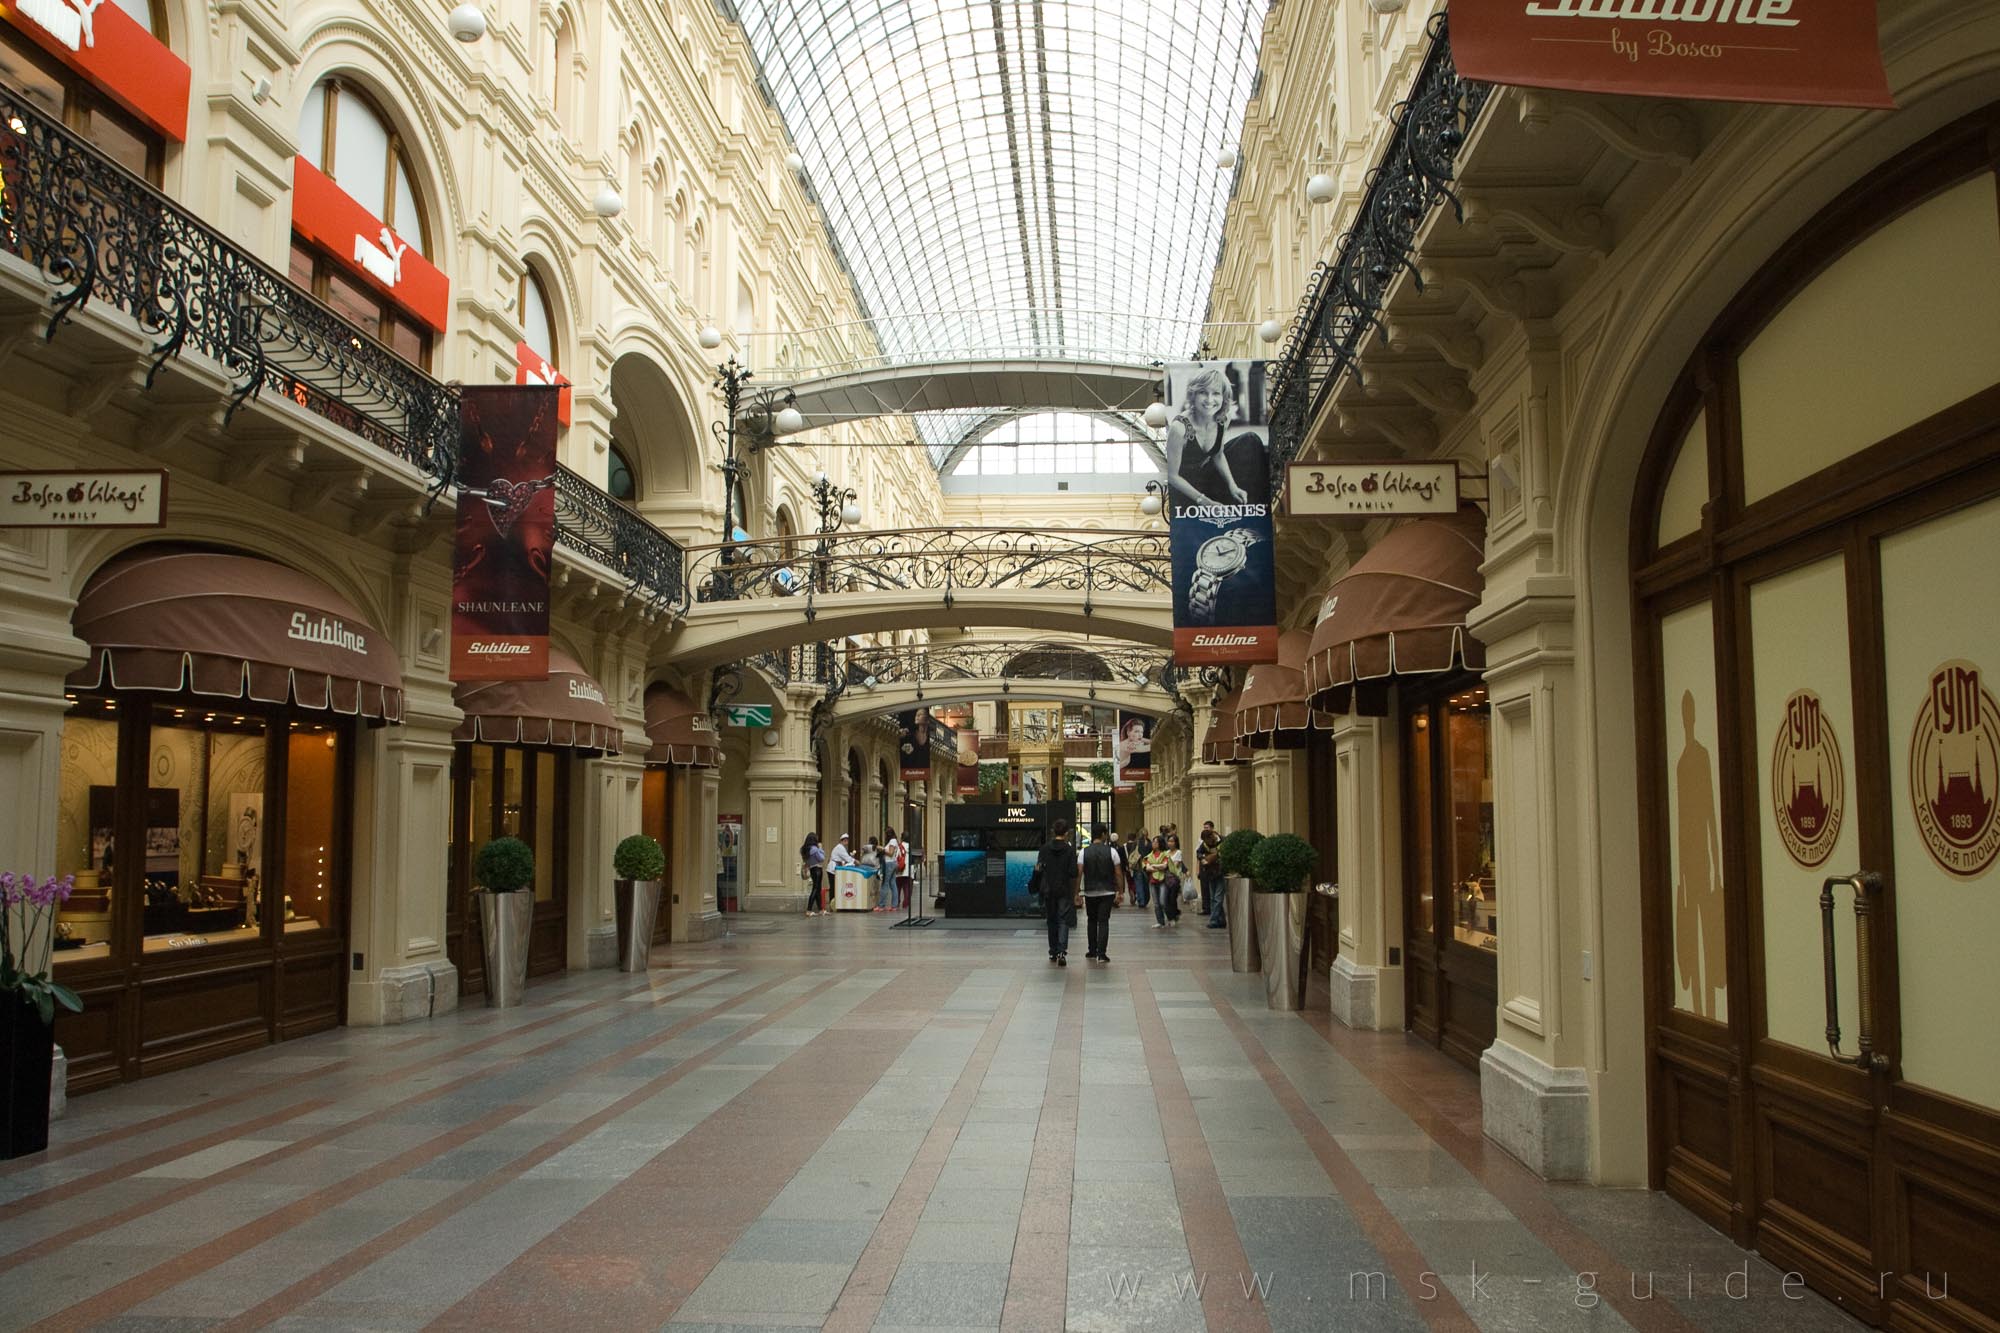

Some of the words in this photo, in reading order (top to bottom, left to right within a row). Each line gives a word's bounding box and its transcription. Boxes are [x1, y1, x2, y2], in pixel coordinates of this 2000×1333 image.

[1611, 27, 1639, 62] by
[1647, 30, 1723, 58] Bosco
[1174, 503, 1267, 519] LONGINES
[1348, 502, 1394, 510] FAMILY
[52, 511, 97, 520] FAMILY
[287, 611, 368, 655] Sublime
[1191, 633, 1259, 647] Sublime
[467, 642, 532, 654] Sublime
[1932, 666, 1981, 734] ГУМ
[1787, 694, 1821, 751] ГУМ
[1007, 808, 1027, 817] IWC
[1800, 816, 1816, 829] 1893
[1950, 814, 1973, 829] 1893
[1777, 807, 1807, 860] КРАСНАЯ
[1917, 804, 1960, 866] КРАСНАЯ
